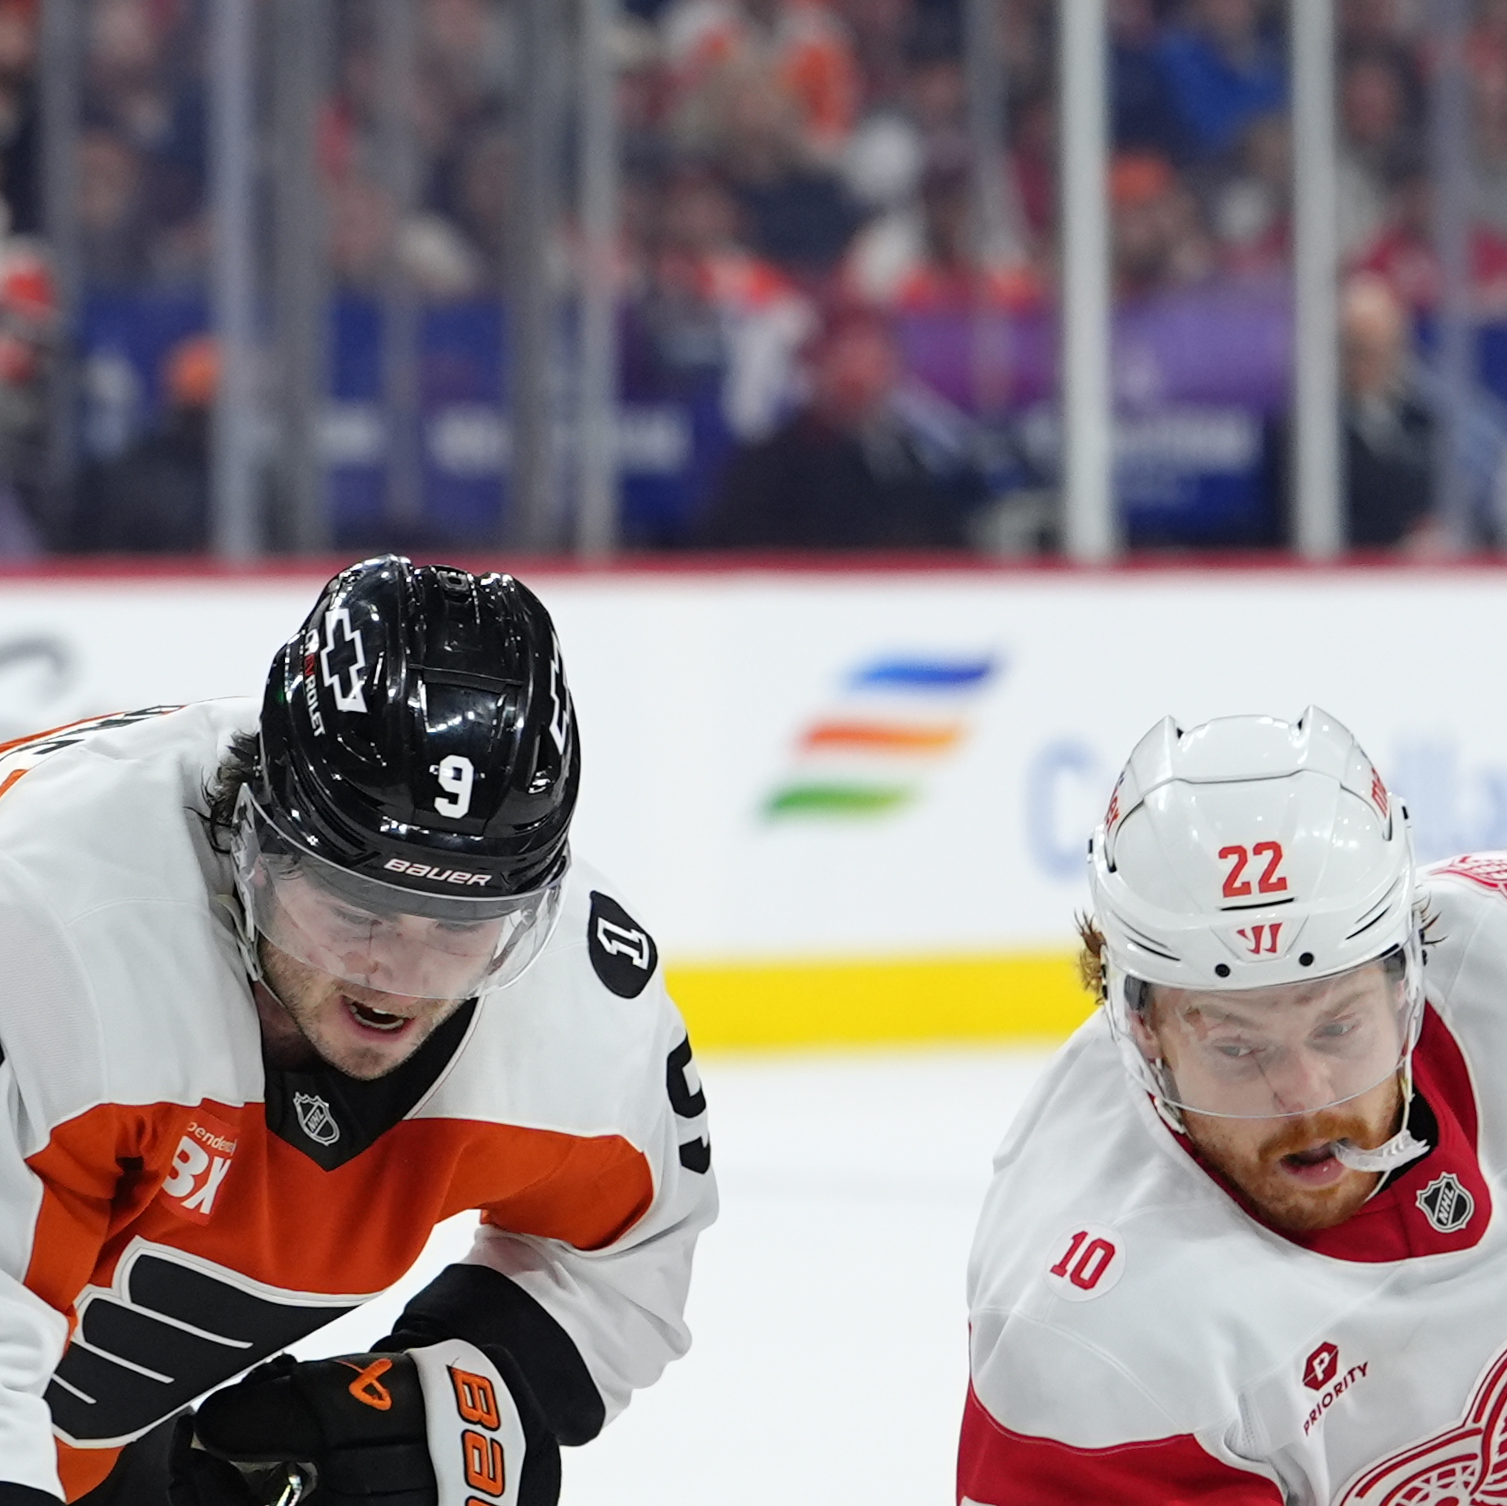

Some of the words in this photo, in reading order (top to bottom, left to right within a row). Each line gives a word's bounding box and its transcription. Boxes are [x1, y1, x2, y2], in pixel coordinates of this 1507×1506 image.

[434, 754, 475, 819] 9
[384, 858, 492, 887] BAUER
[1218, 841, 1288, 898] 22
[1050, 1230, 1116, 1291] 10
[1303, 1361, 1368, 1437] PRIORITY
